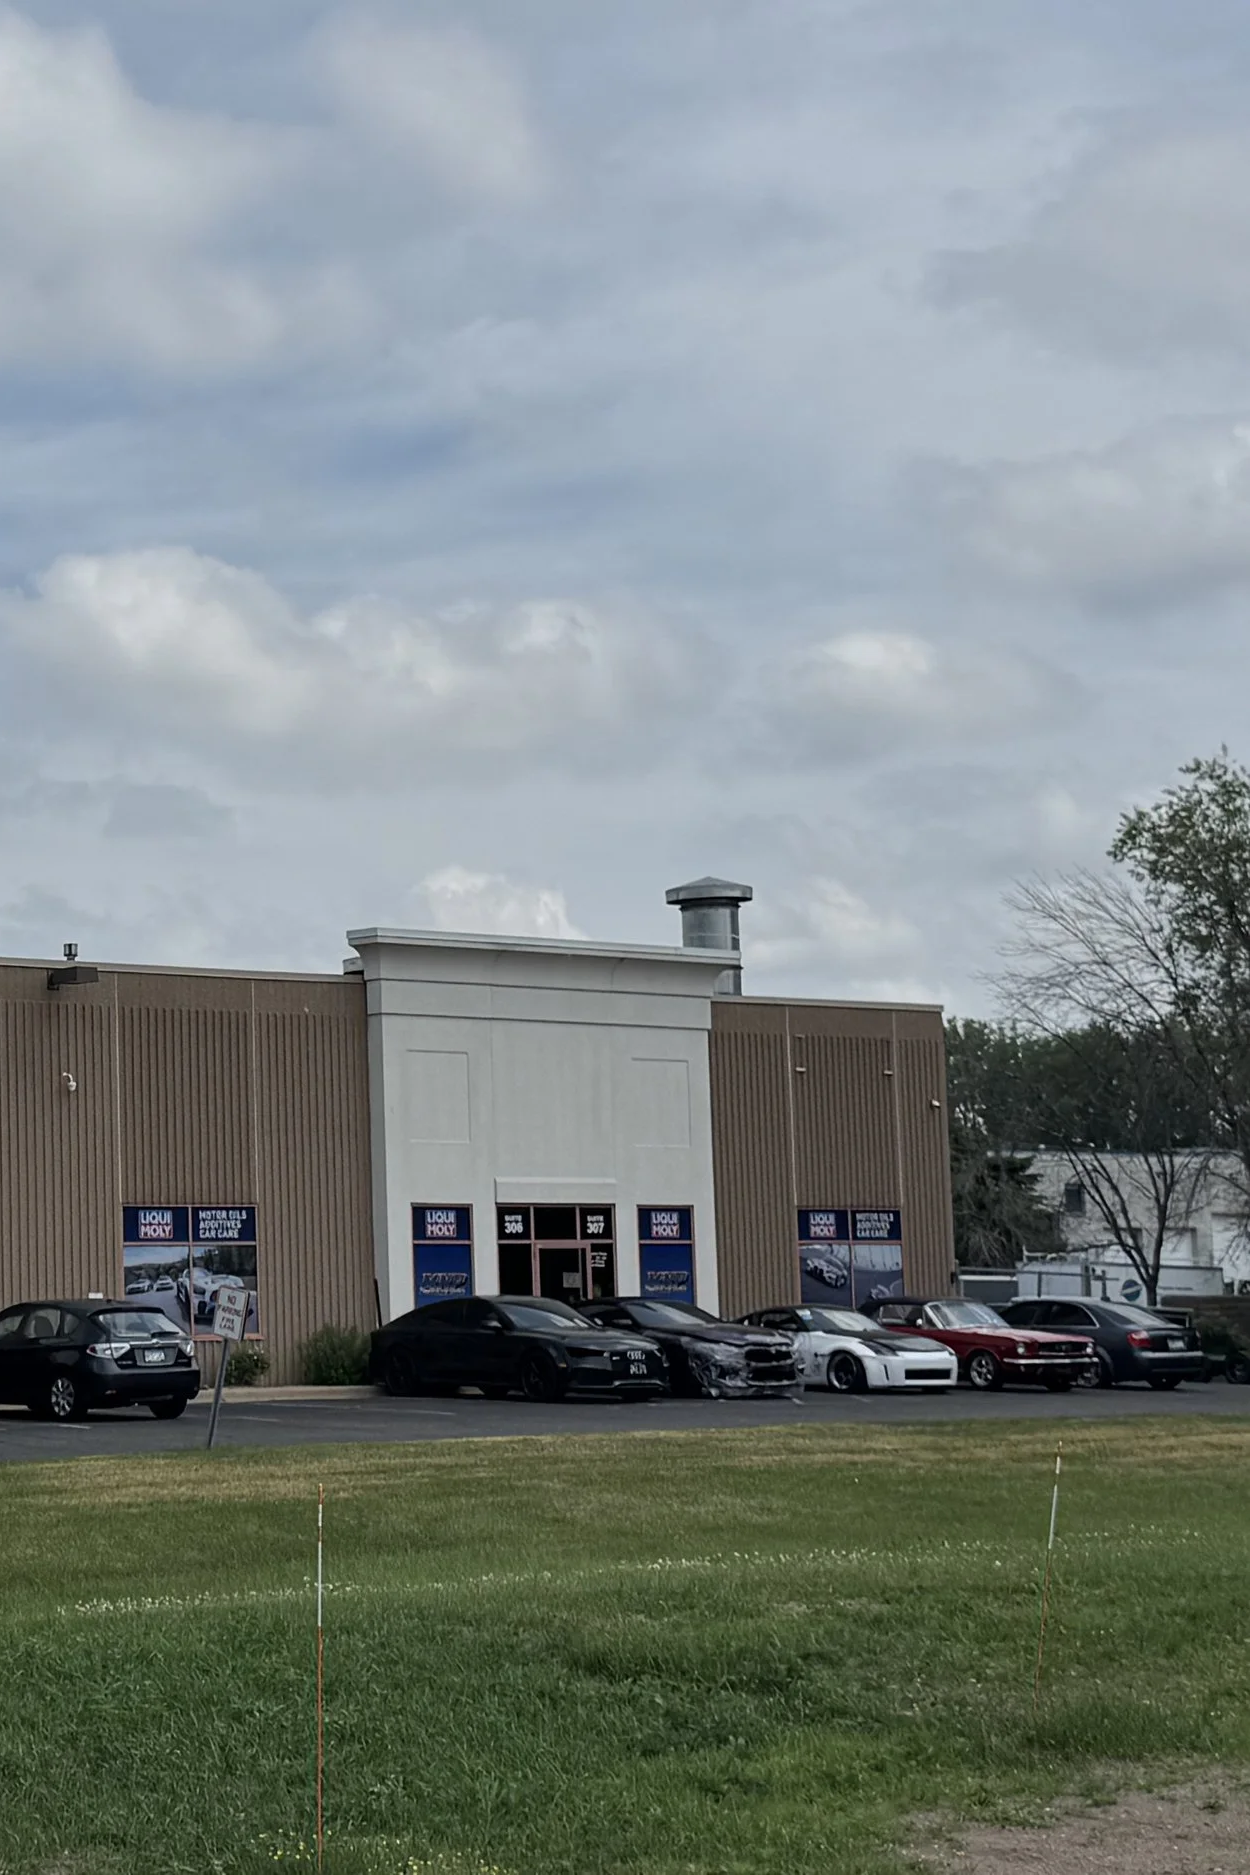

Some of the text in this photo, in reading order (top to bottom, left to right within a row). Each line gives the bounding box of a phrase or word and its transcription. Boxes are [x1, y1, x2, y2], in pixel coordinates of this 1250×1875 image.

[140, 1211, 171, 1224] LIQUI
[198, 1210, 227, 1219] MOTOR
[427, 1210, 455, 1223] LIQUI
[651, 1212, 678, 1224] LIQUI
[810, 1212, 835, 1224] LIQUI
[199, 1220, 242, 1229] ADDITIVES
[427, 1224, 456, 1236] MOLY
[504, 1222, 523, 1234] 306
[587, 1222, 605, 1234] 307
[652, 1224, 680, 1237] MOLY
[140, 1225, 172, 1238] MOLY
[199, 1229, 239, 1239] CAR CARE
[810, 1225, 836, 1237] MOLY
[227, 1294, 237, 1306] NO
